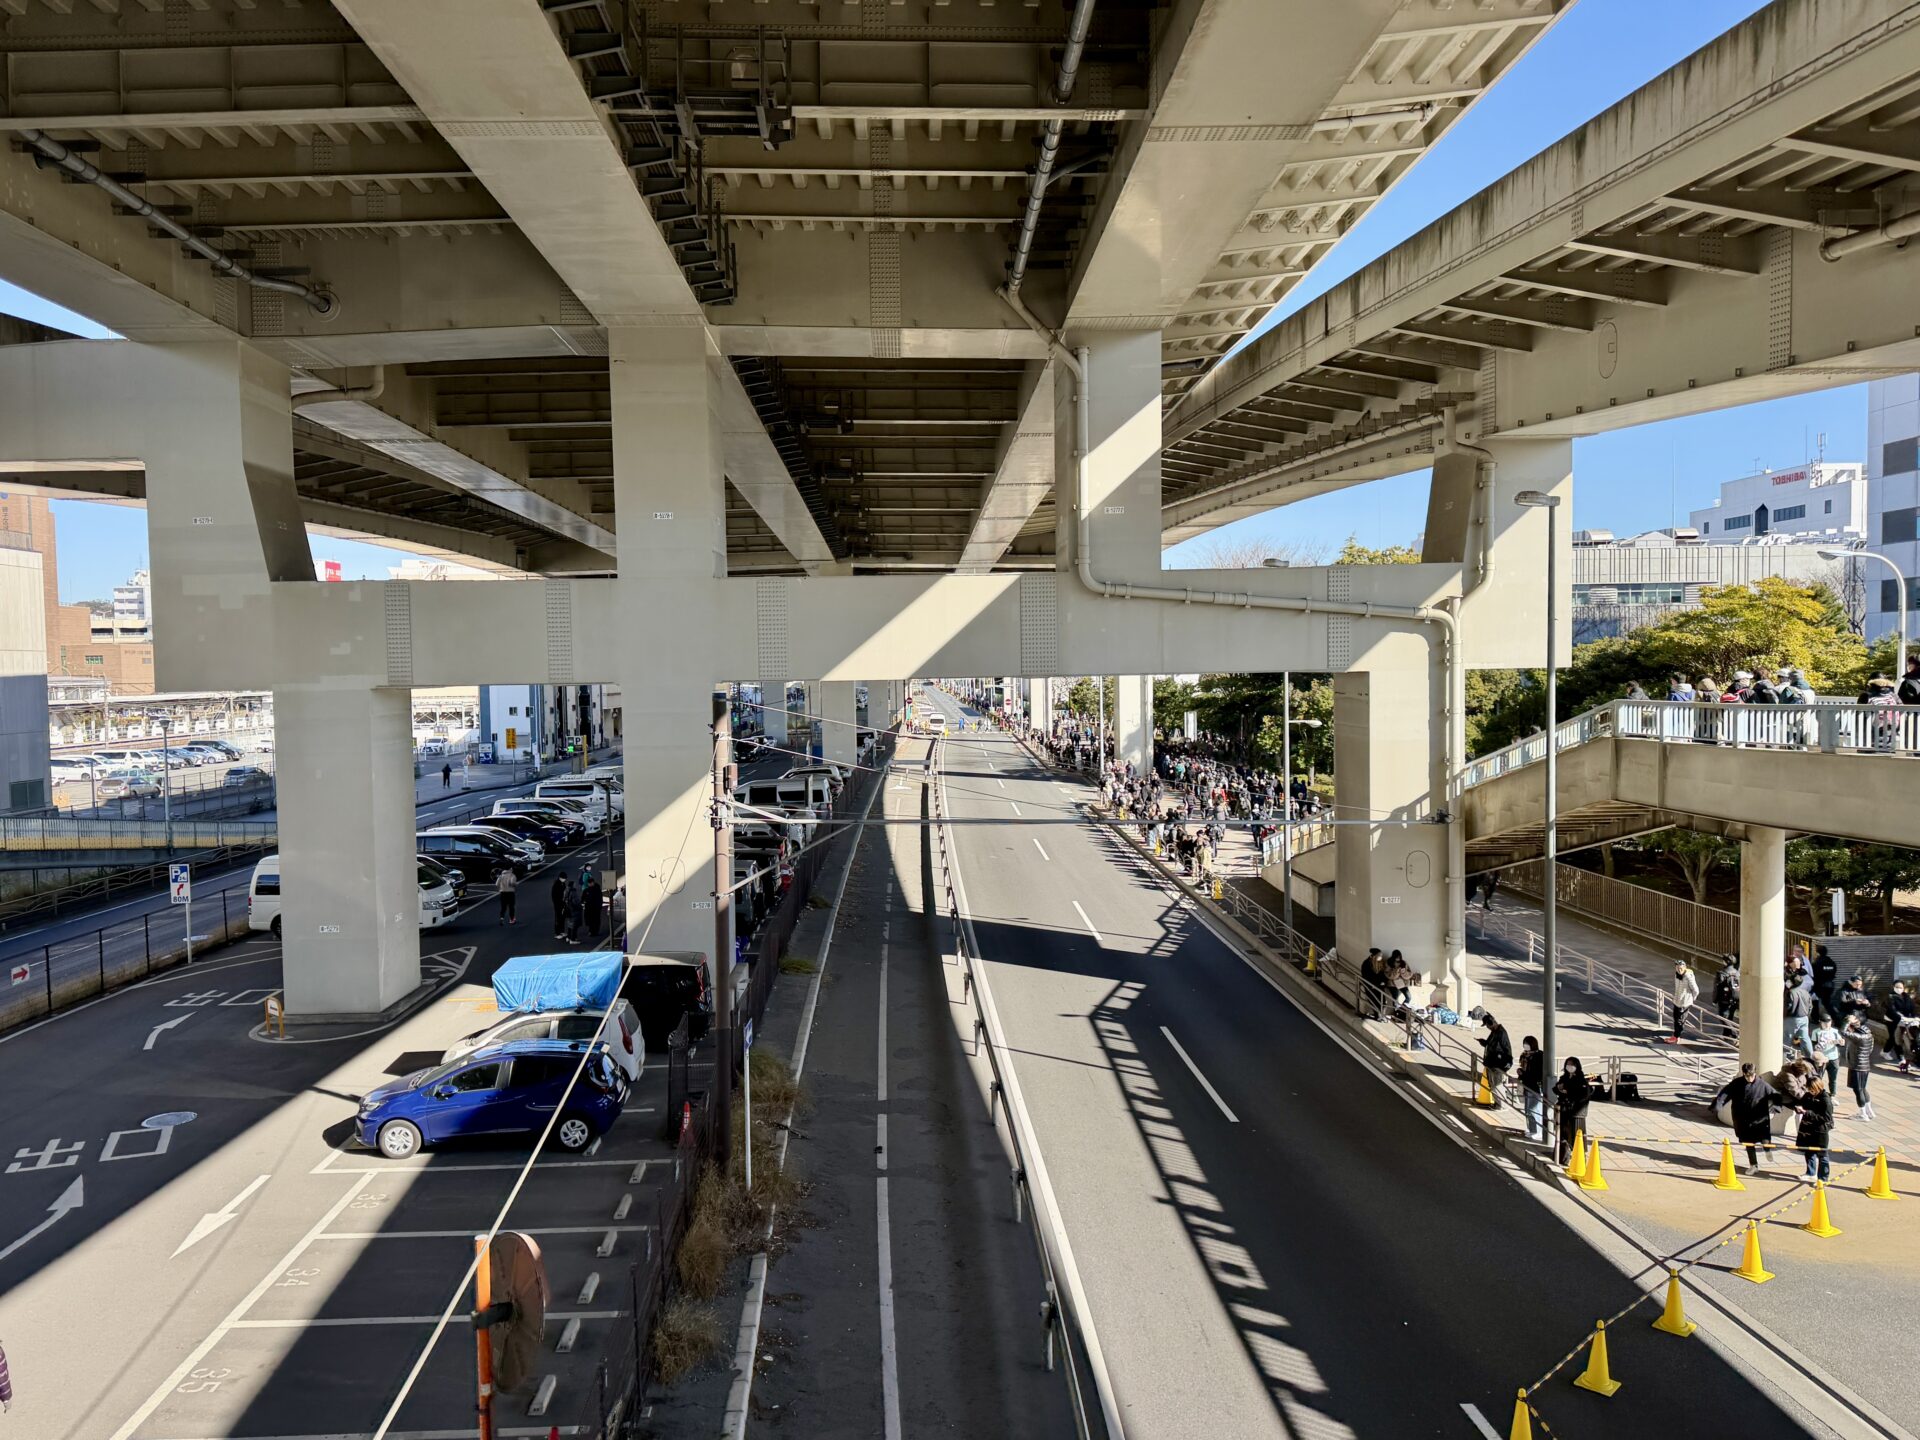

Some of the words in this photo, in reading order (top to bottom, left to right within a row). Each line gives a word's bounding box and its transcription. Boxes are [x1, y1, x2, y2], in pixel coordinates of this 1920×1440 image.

[1771, 471, 1807, 486] TOSHIBA
[172, 869, 180, 880] P
[163, 990, 285, 1006] 出口
[5, 1125, 174, 1173] 出口
[350, 1193, 387, 1209] 33
[274, 1268, 321, 1287] 34
[177, 1368, 232, 1393] 35
